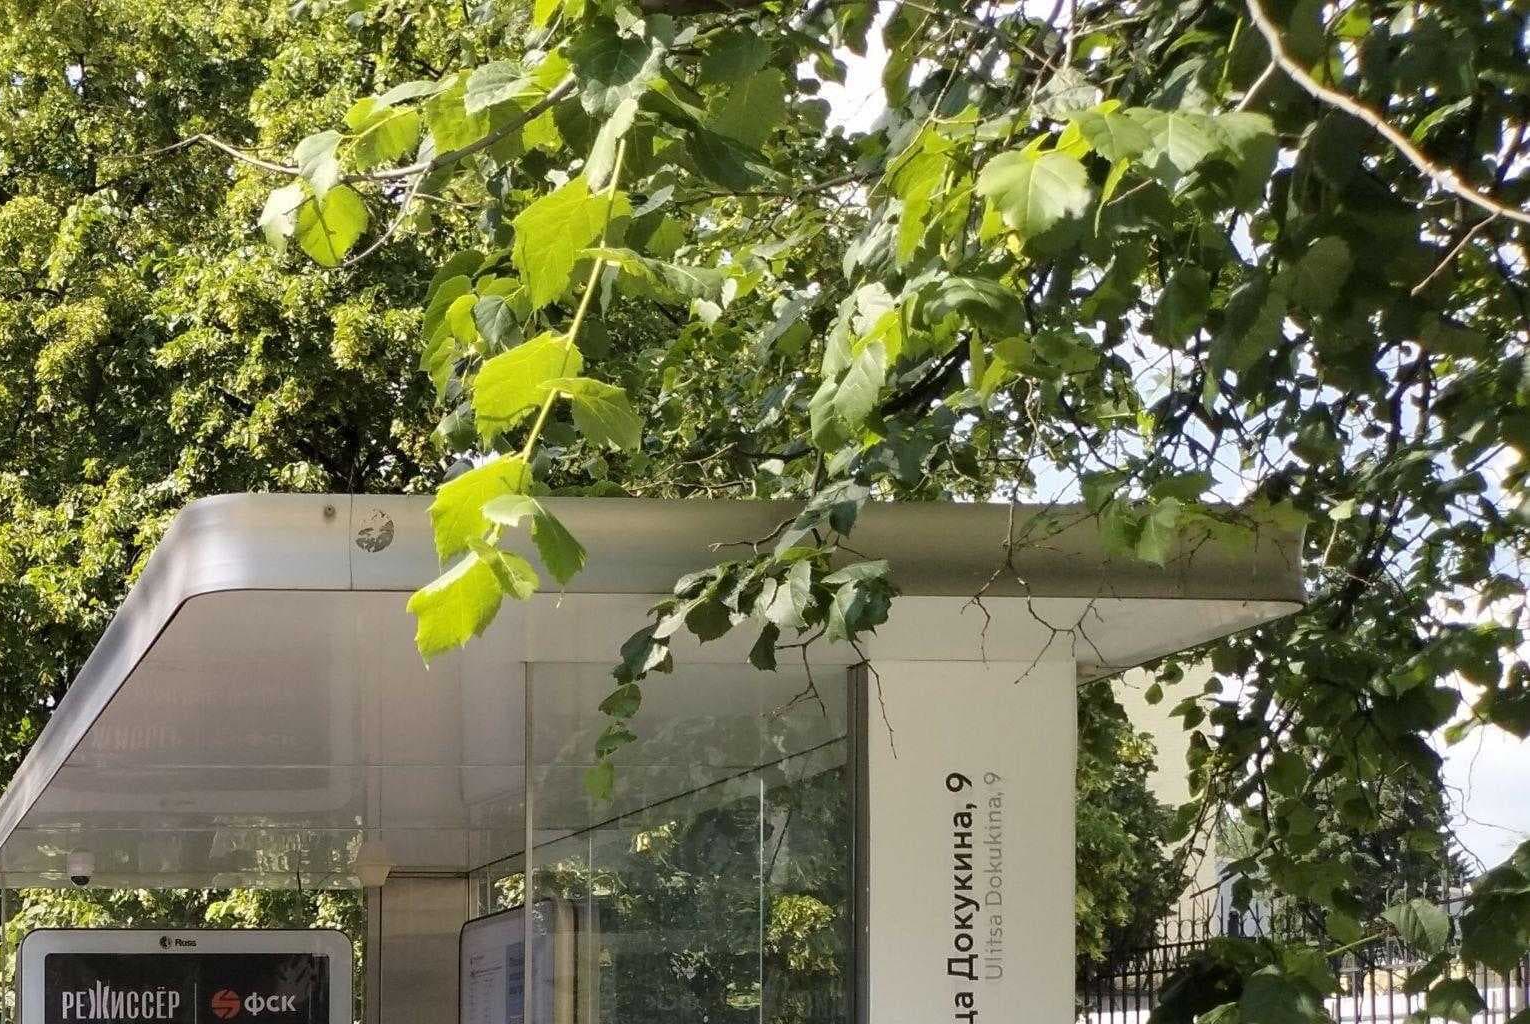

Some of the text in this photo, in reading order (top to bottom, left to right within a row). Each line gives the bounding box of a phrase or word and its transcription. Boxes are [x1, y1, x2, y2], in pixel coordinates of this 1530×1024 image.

[944, 771, 974, 794] 9
[946, 800, 981, 982] Докукина,
[982, 770, 1005, 981] Ulitsa Dokukina, 9
[243, 991, 297, 1017] ФСК
